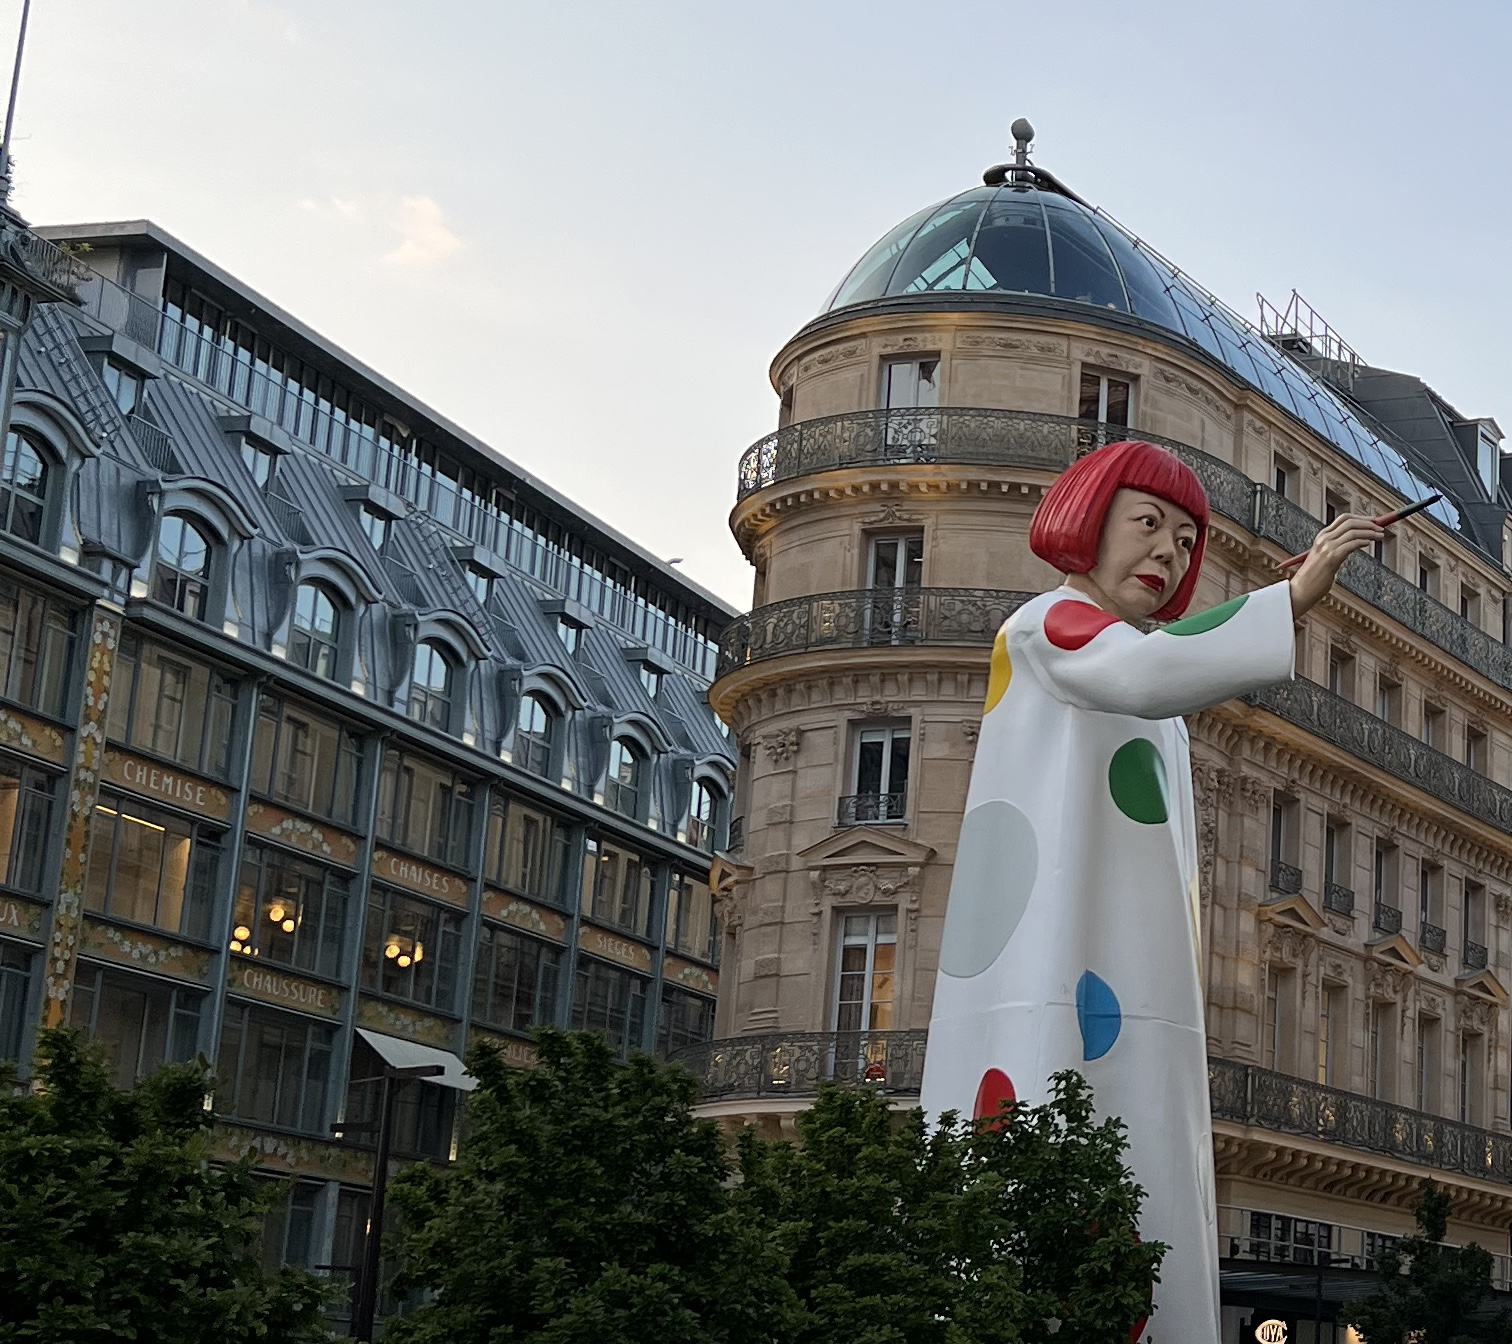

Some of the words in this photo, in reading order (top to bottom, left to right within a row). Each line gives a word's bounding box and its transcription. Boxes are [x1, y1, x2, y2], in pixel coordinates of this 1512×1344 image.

[123, 760, 206, 806] CHEMISE
[390, 858, 450, 893] CHAISES
[243, 969, 327, 1007] CHAUSSURE
